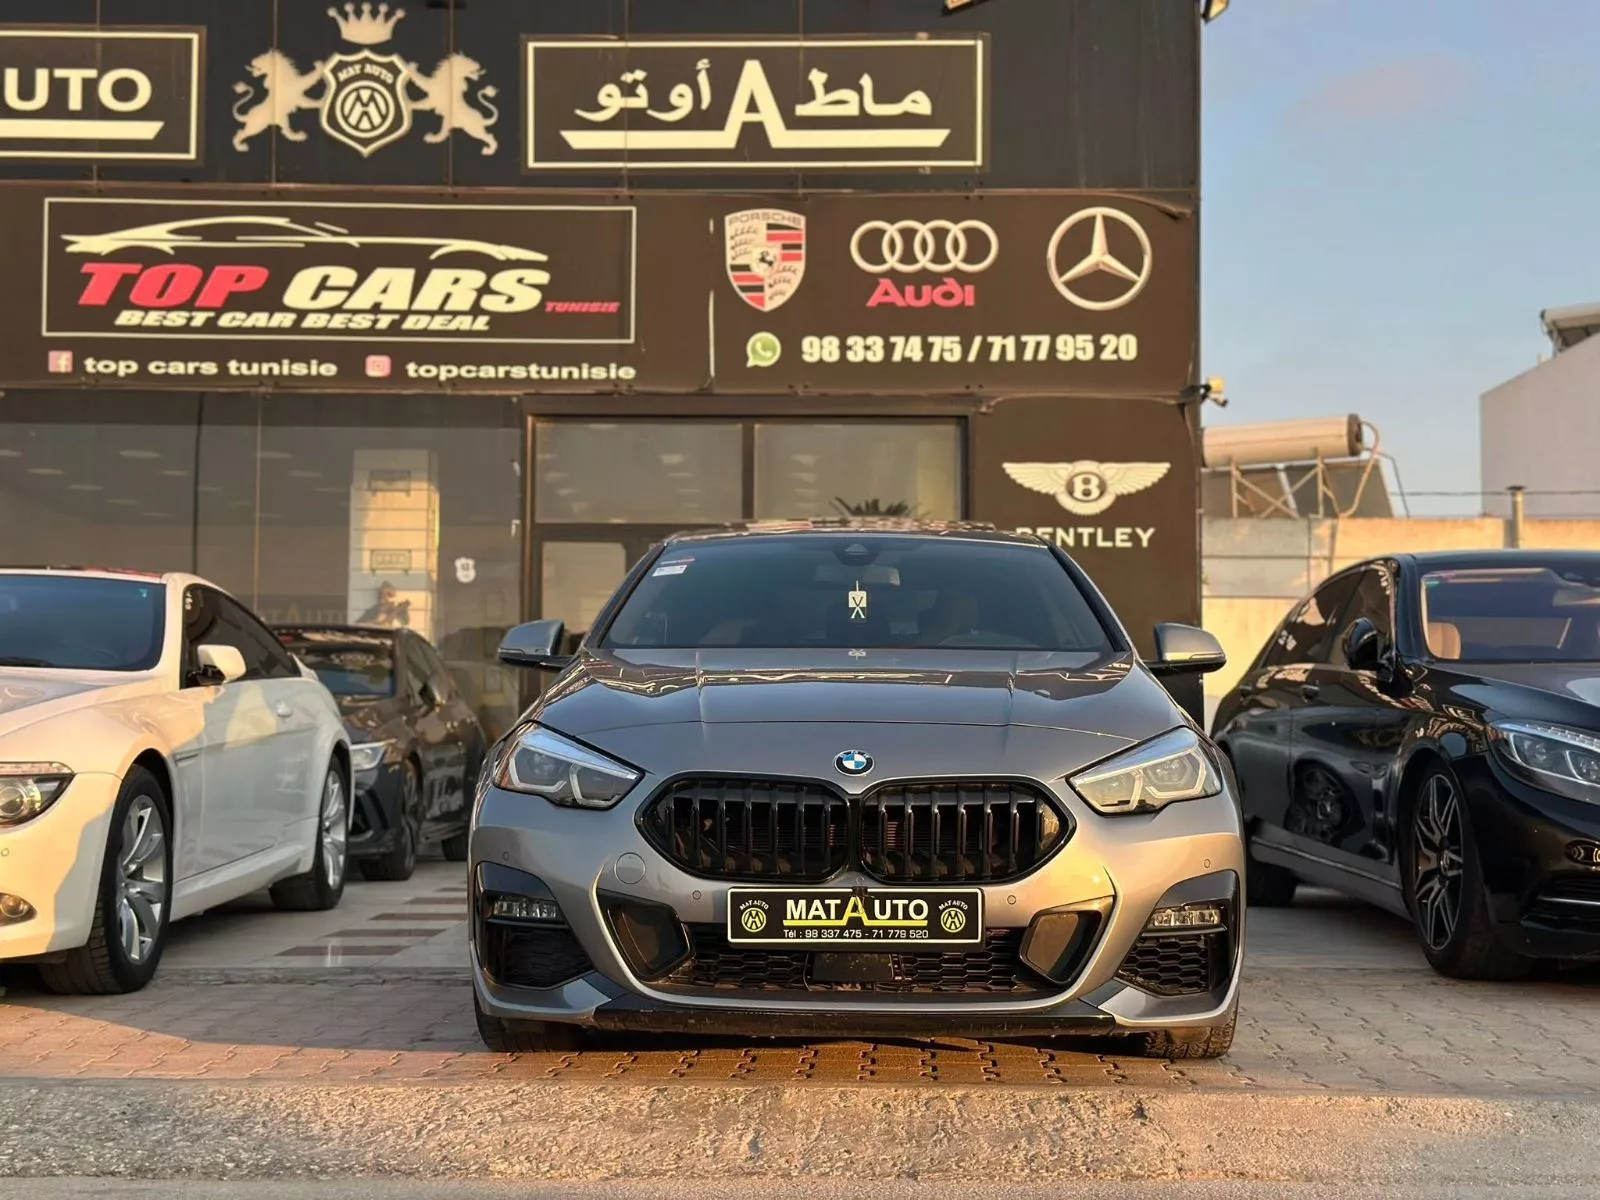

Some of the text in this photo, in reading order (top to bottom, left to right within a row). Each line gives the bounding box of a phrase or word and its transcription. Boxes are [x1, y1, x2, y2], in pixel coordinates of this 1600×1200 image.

[575, 58, 712, 122] أوتو
[795, 68, 932, 116] ماط
[728, 211, 802, 227] PORSCHE
[78, 262, 551, 313] TOP CARS
[544, 301, 620, 314] TUNISIE
[114, 309, 491, 331] BEST CAR BEST DEAL
[801, 334, 1138, 363] 98 33 74 75 / 71 77 95 20
[83, 357, 338, 378] top cars tunisie
[405, 361, 638, 382] topcarstunisie
[753, 900, 769, 910] AUTO
[952, 900, 969, 910] AUTO
[804, 929, 819, 938] 98
[821, 929, 840, 938] 337
[842, 929, 862, 938] 475
[872, 929, 884, 938] 71
[887, 929, 907, 938] 779
[909, 929, 929, 938] 520
